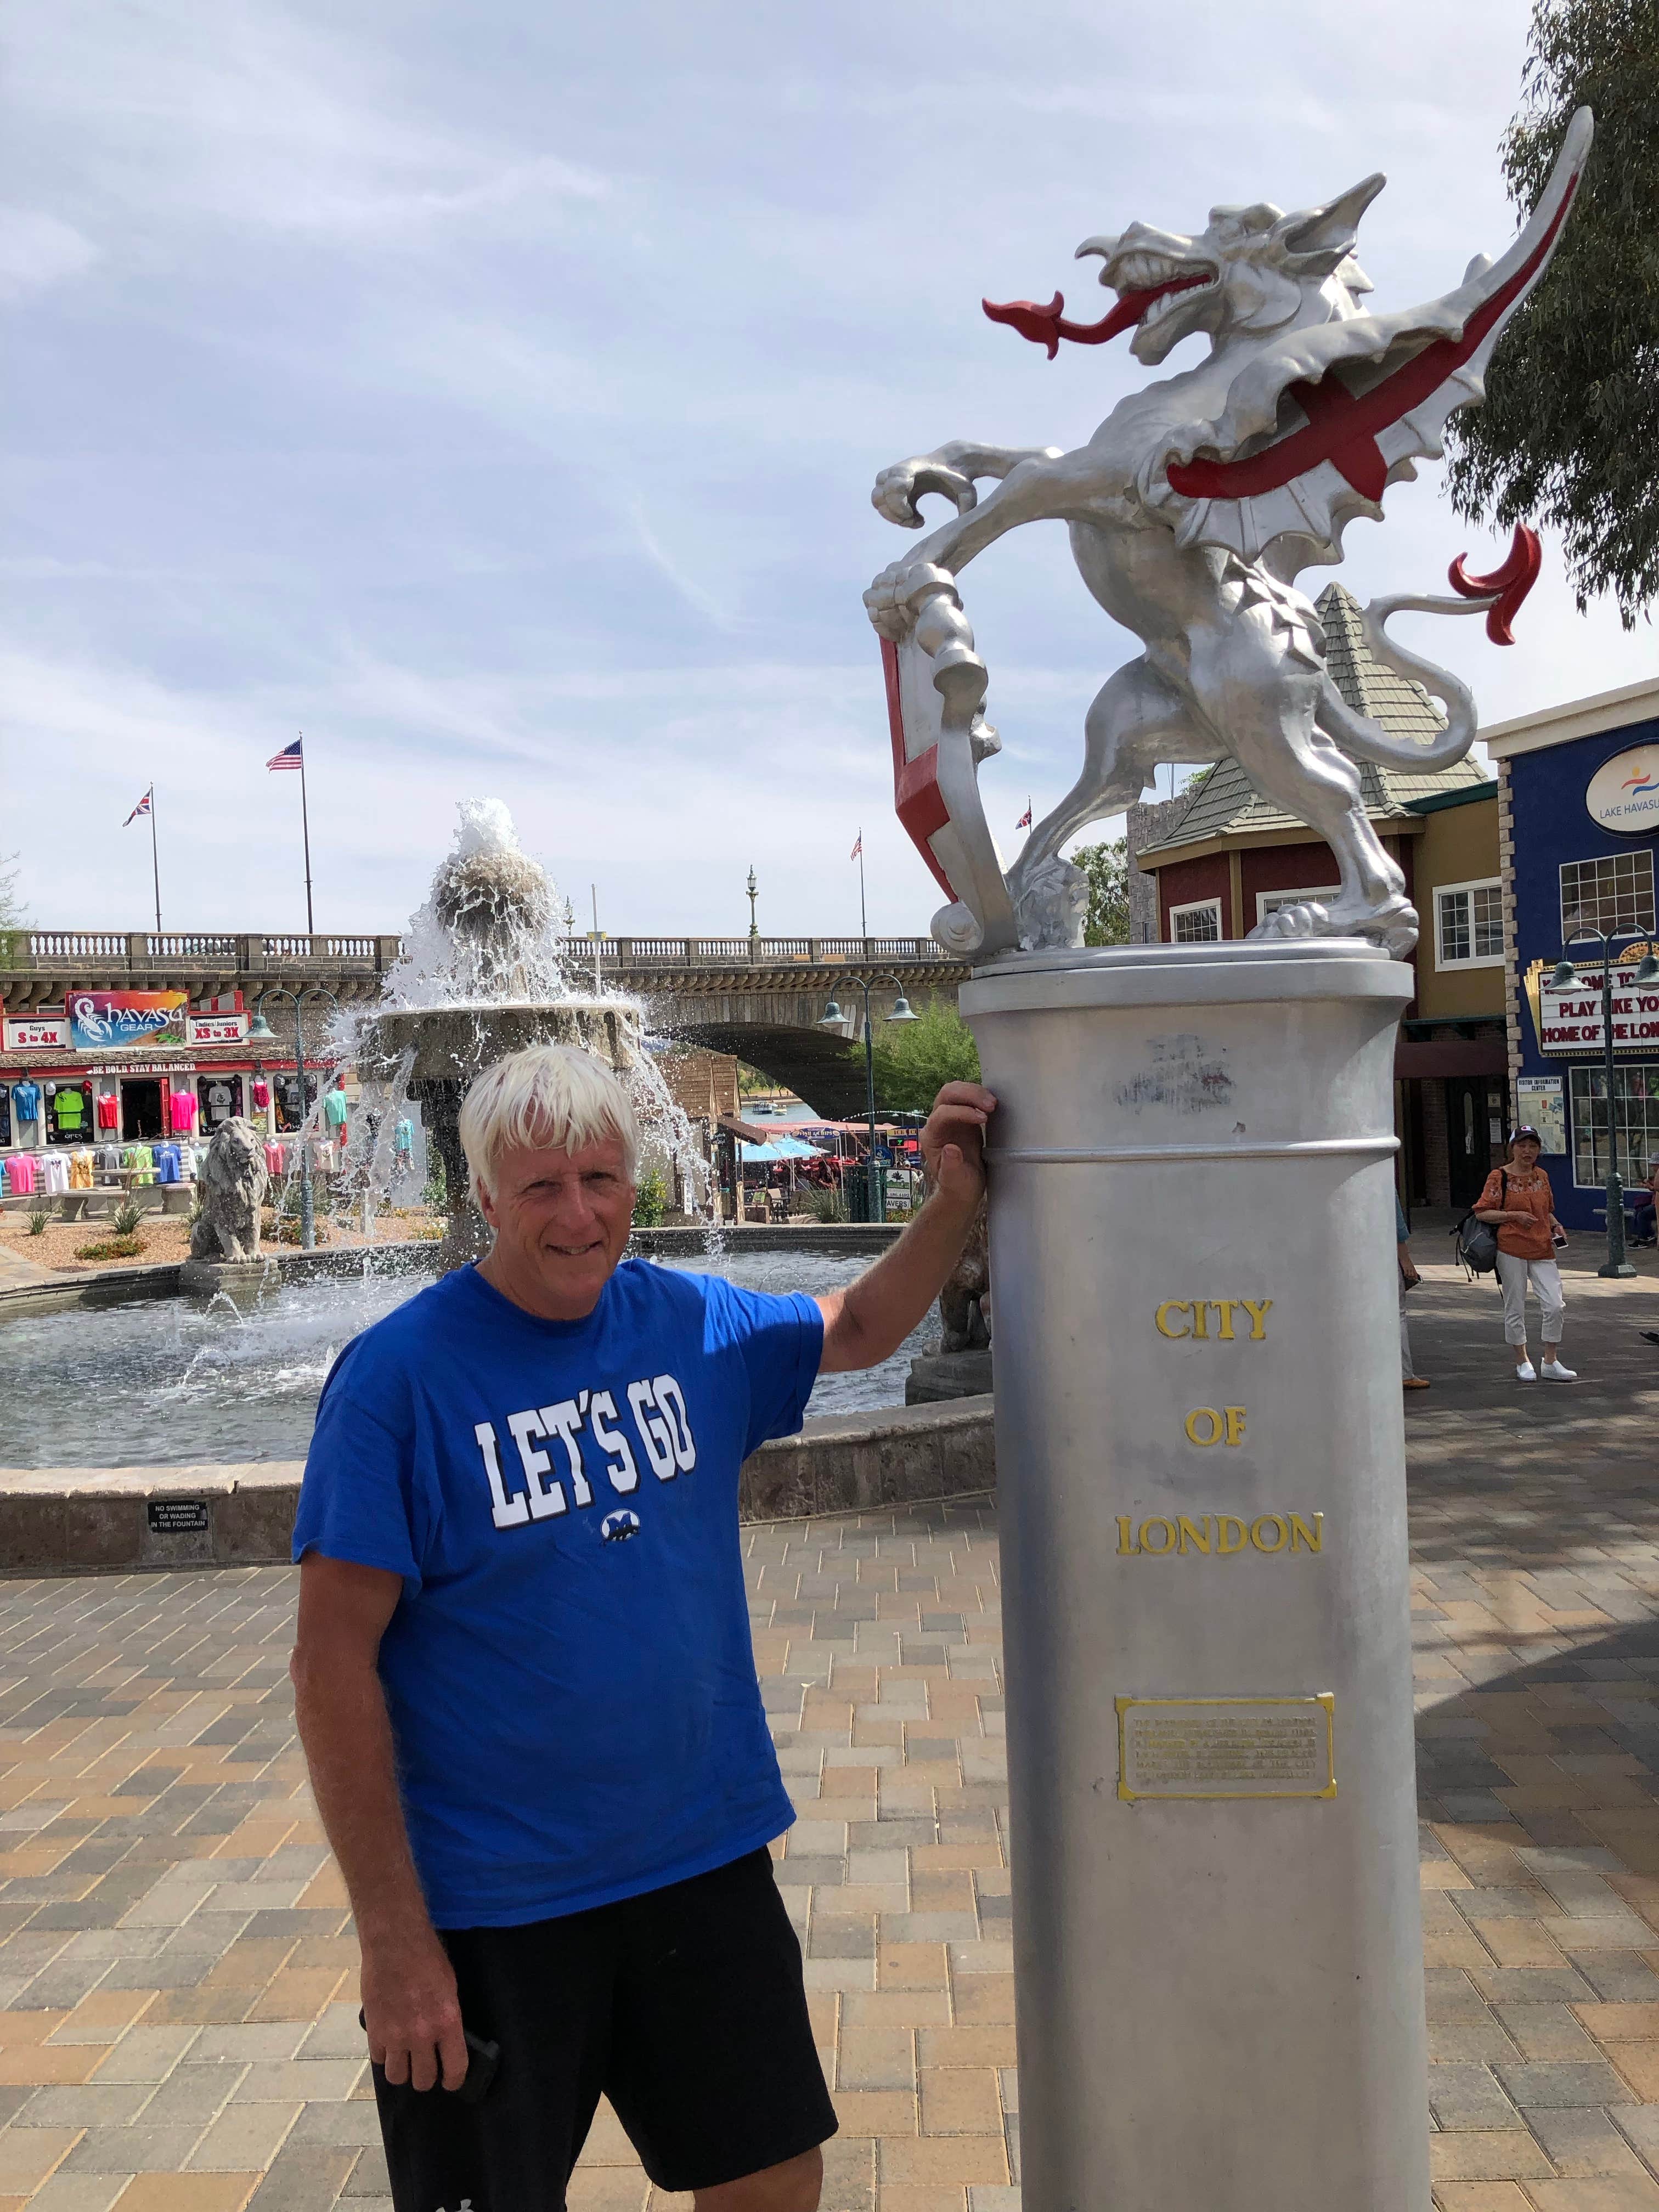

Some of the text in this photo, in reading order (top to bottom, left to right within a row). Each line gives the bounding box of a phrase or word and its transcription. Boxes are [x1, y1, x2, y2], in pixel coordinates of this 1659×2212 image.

[1600, 799, 1659, 819] LAKE HAVASU
[1559, 1000, 1597, 1018] PLAY
[18, 1032, 27, 1043] S
[41, 1031, 58, 1043] 4X
[195, 1028, 211, 1039] XS
[224, 1026, 239, 1038] 3X
[1541, 1025, 1580, 1043] HOME
[1581, 1024, 1601, 1041] OF
[1602, 1023, 1628, 1040] HE
[93, 1066, 103, 1074] BE
[130, 1064, 151, 1073] STAY
[1154, 1299, 1273, 1340] CITY
[1184, 1405, 1247, 1446] OF
[475, 1373, 696, 1531] LET'S GO
[1115, 1511, 1324, 1554] LONDON
